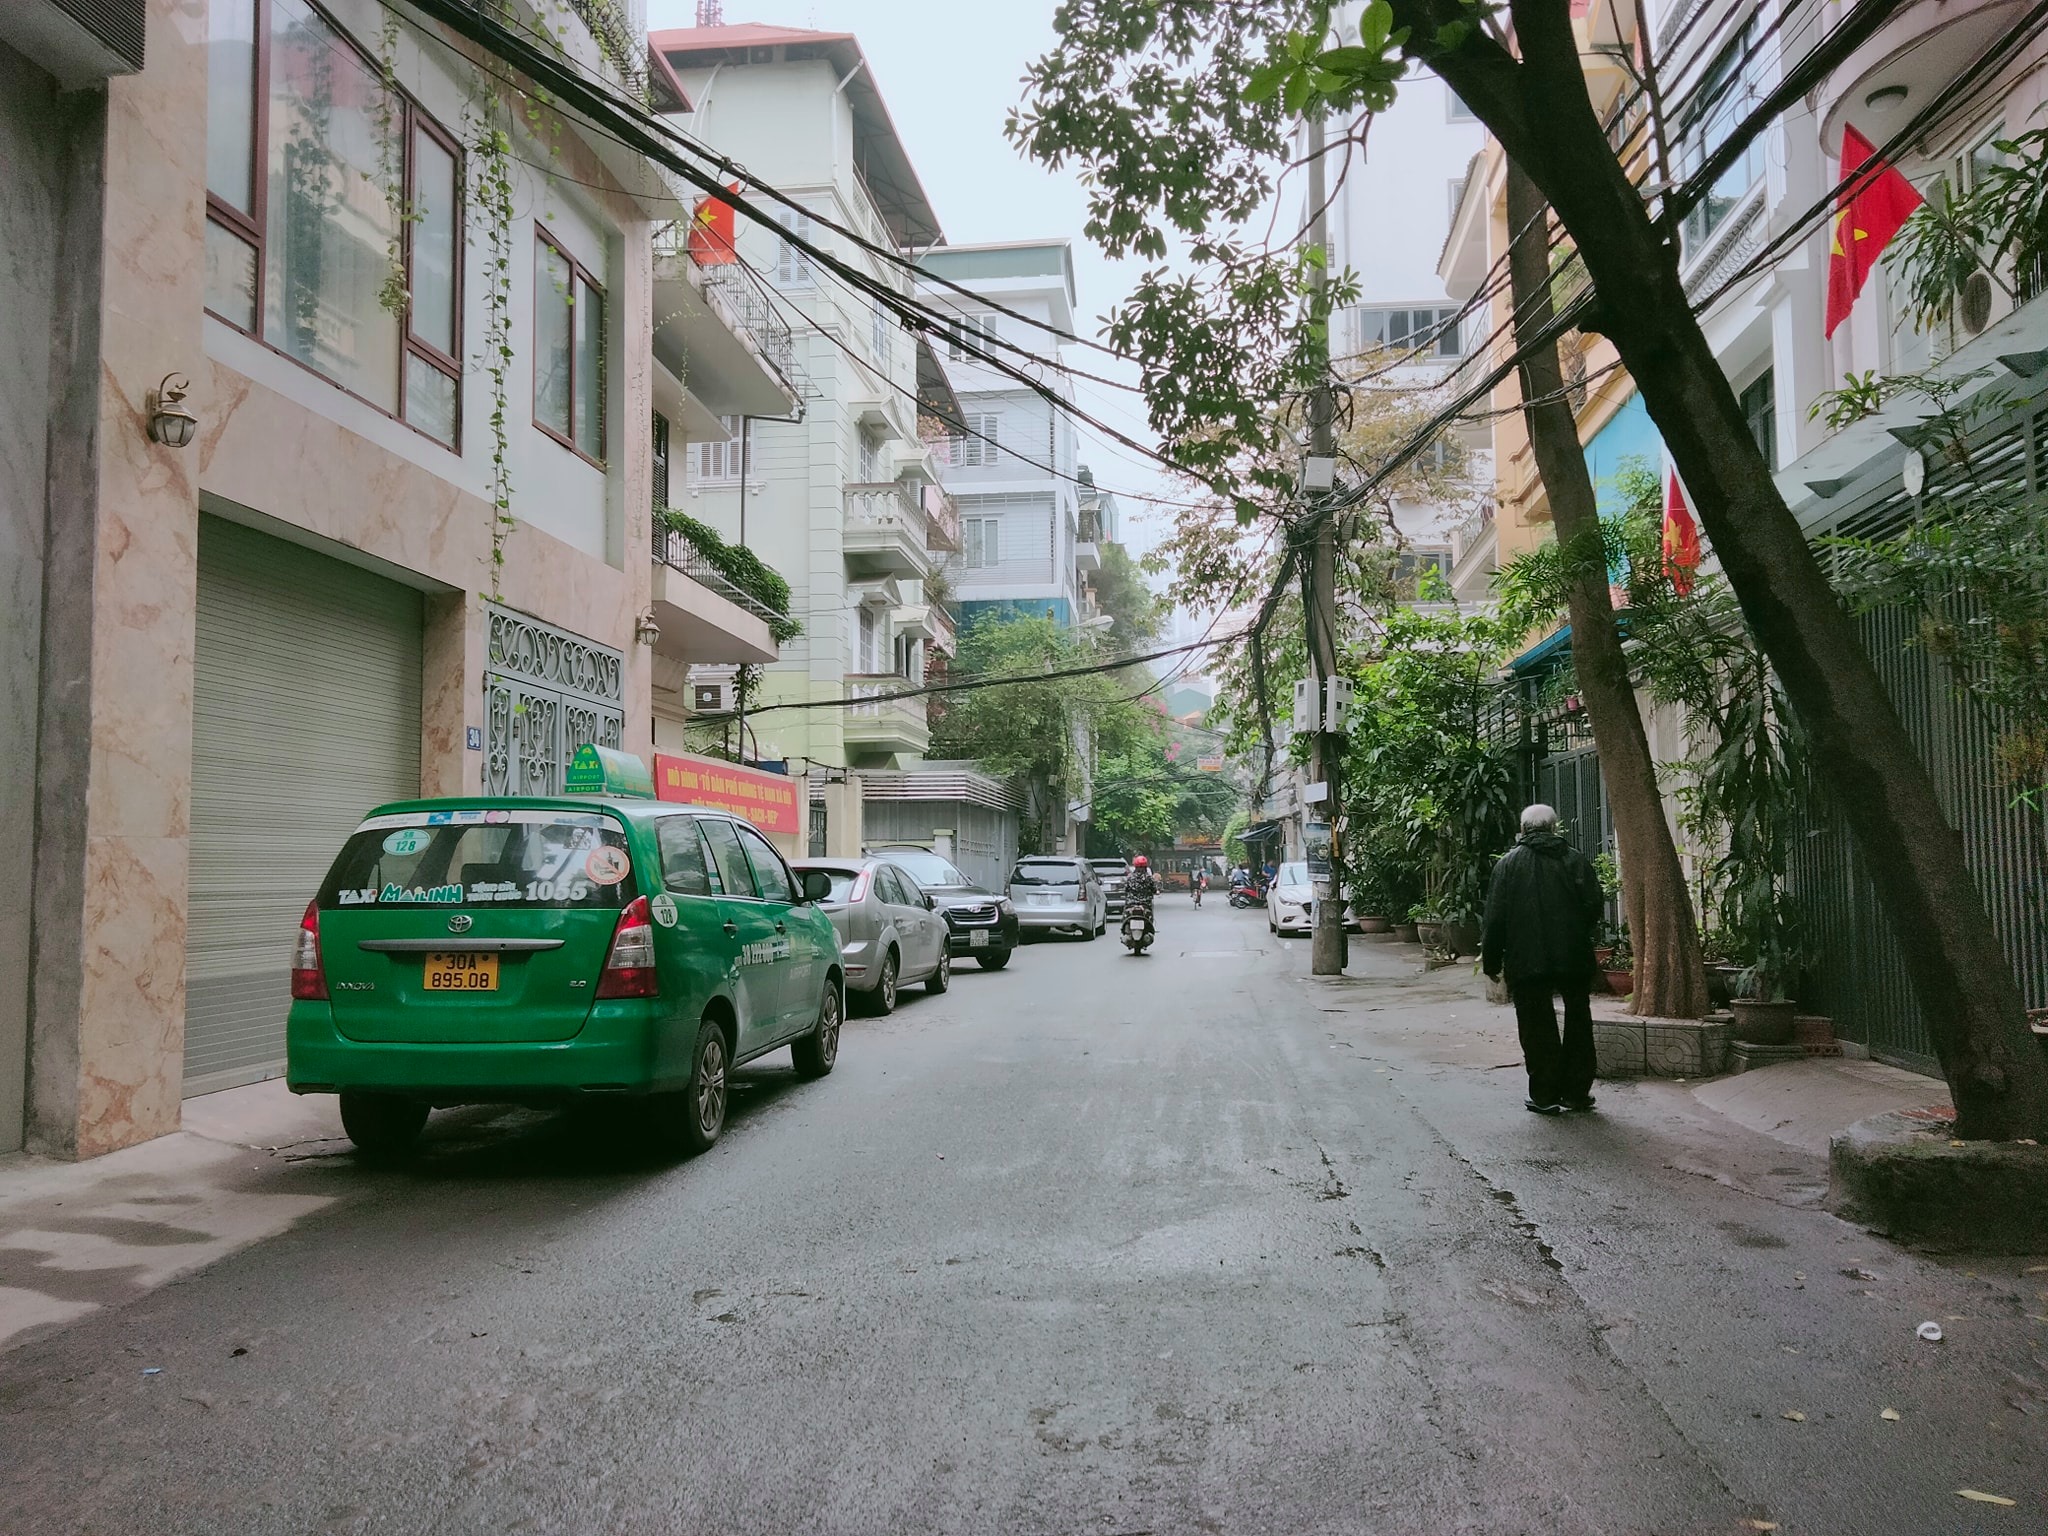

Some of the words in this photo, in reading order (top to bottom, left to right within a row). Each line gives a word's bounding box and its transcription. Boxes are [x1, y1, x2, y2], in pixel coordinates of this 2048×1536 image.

[667, 766, 680, 786] MÔ
[680, 768, 698, 789] HÌNH
[395, 840, 416, 851] 128
[526, 880, 588, 901] 1055
[661, 908, 673, 924] 128
[446, 954, 477, 970] 30A
[336, 982, 375, 990] INNOVA
[432, 972, 489, 988] 895.08
